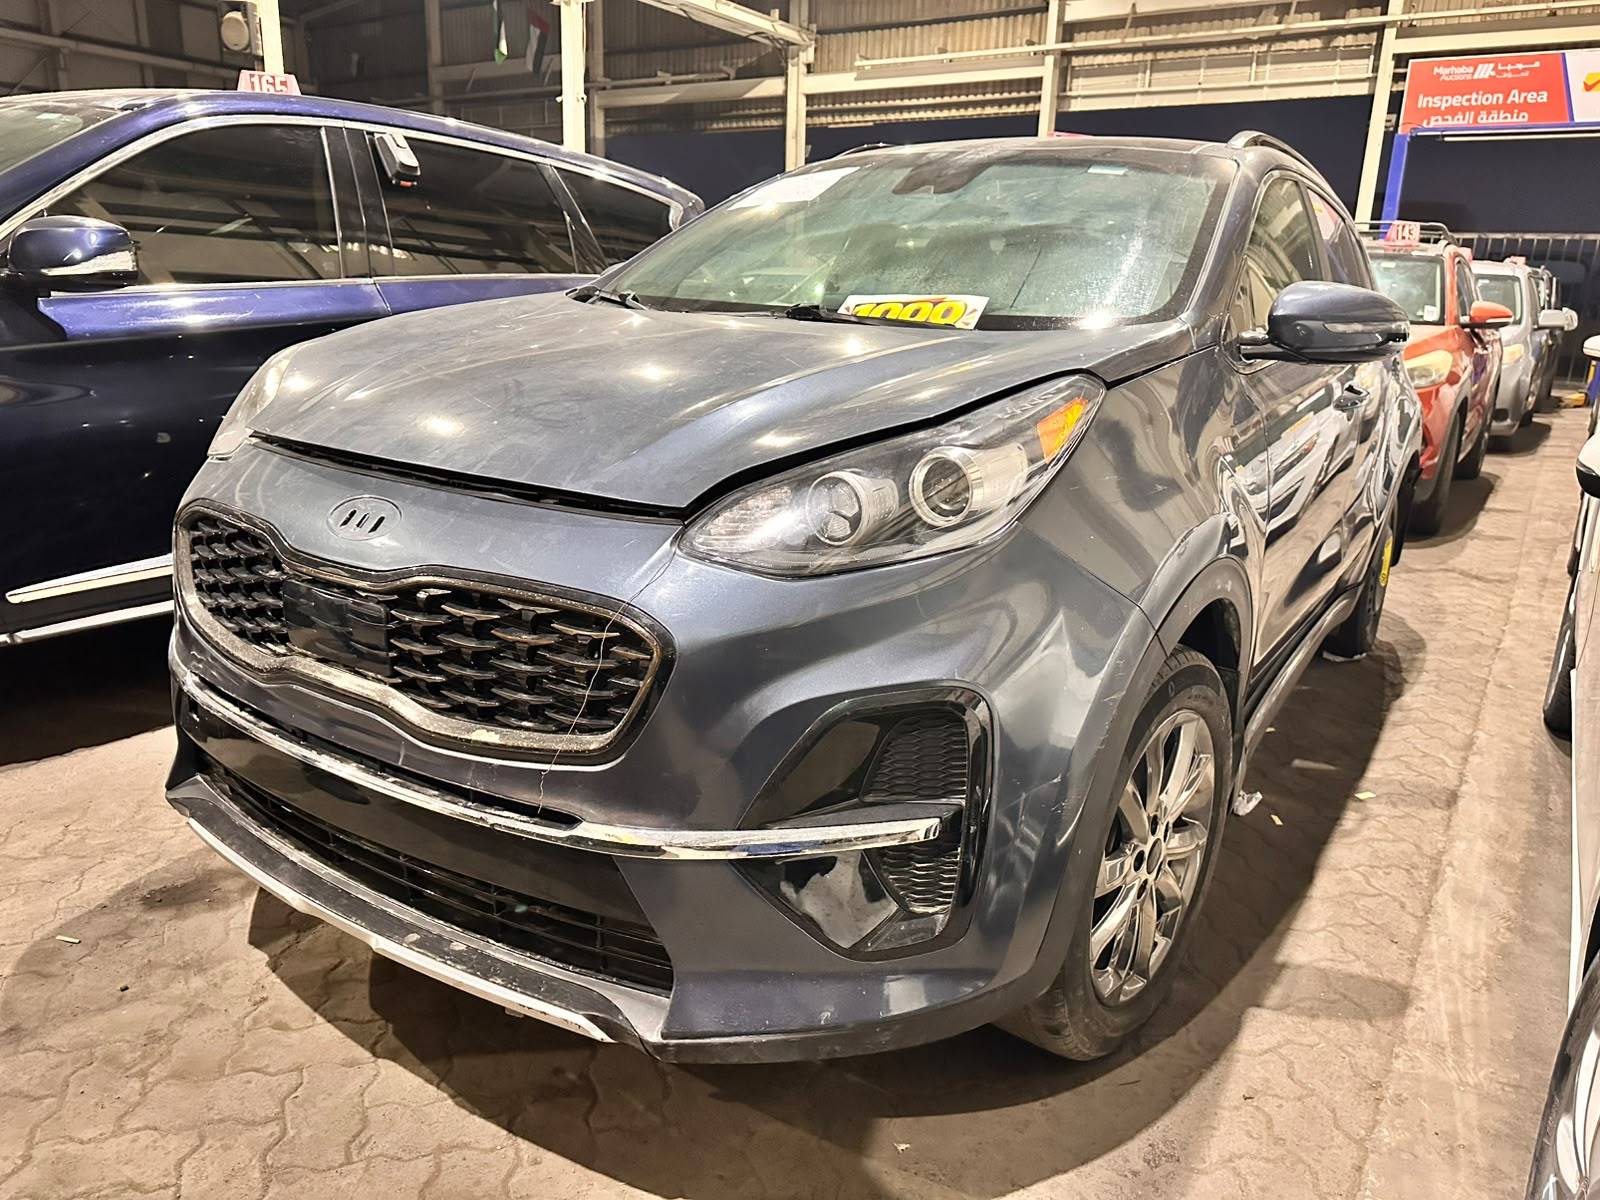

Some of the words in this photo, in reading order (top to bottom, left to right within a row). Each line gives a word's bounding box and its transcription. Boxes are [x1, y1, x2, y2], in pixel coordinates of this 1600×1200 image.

[1433, 65, 1474, 75] Marhaba
[249, 74, 288, 93] 165
[1417, 91, 1504, 110] Inspection
[1507, 89, 1549, 104] Area
[1422, 111, 1475, 128] الفحص
[1477, 109, 1529, 123] منطقة
